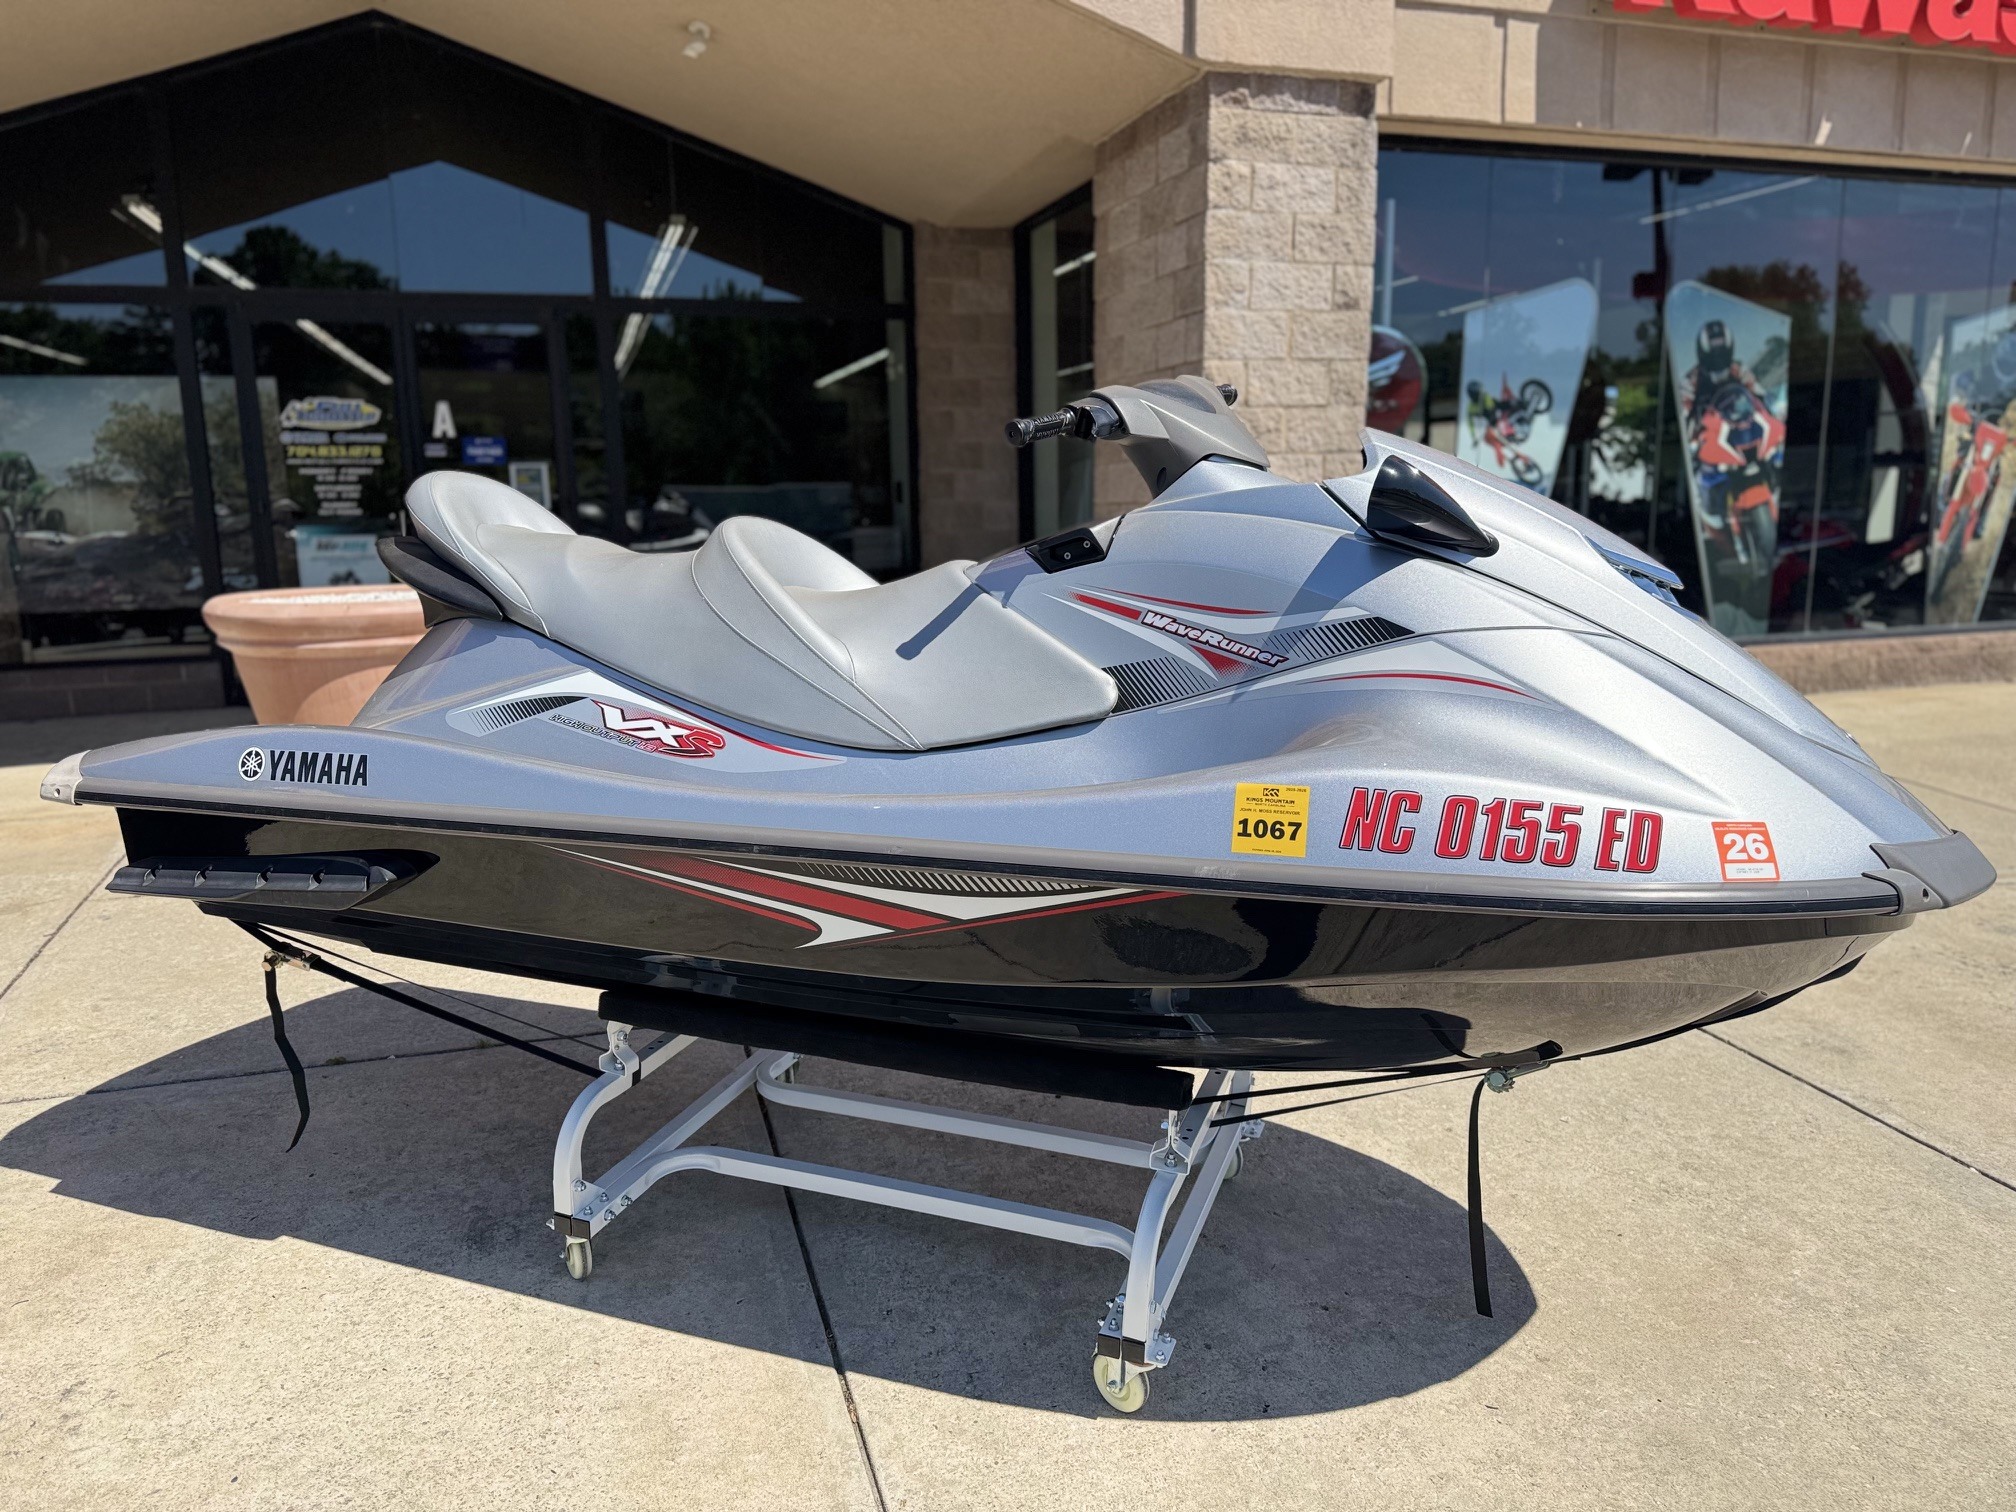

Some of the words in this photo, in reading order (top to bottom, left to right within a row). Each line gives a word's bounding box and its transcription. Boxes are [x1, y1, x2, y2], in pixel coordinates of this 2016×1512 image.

[432, 400, 457, 439] A
[1141, 610, 1289, 667] WaveRunner
[270, 750, 368, 786] YAMAHA
[1237, 818, 1302, 841] 1067
[1339, 787, 1422, 854] NC
[1434, 794, 1583, 868] 0155
[1594, 807, 1663, 873] ED
[1723, 832, 1769, 861] 26
